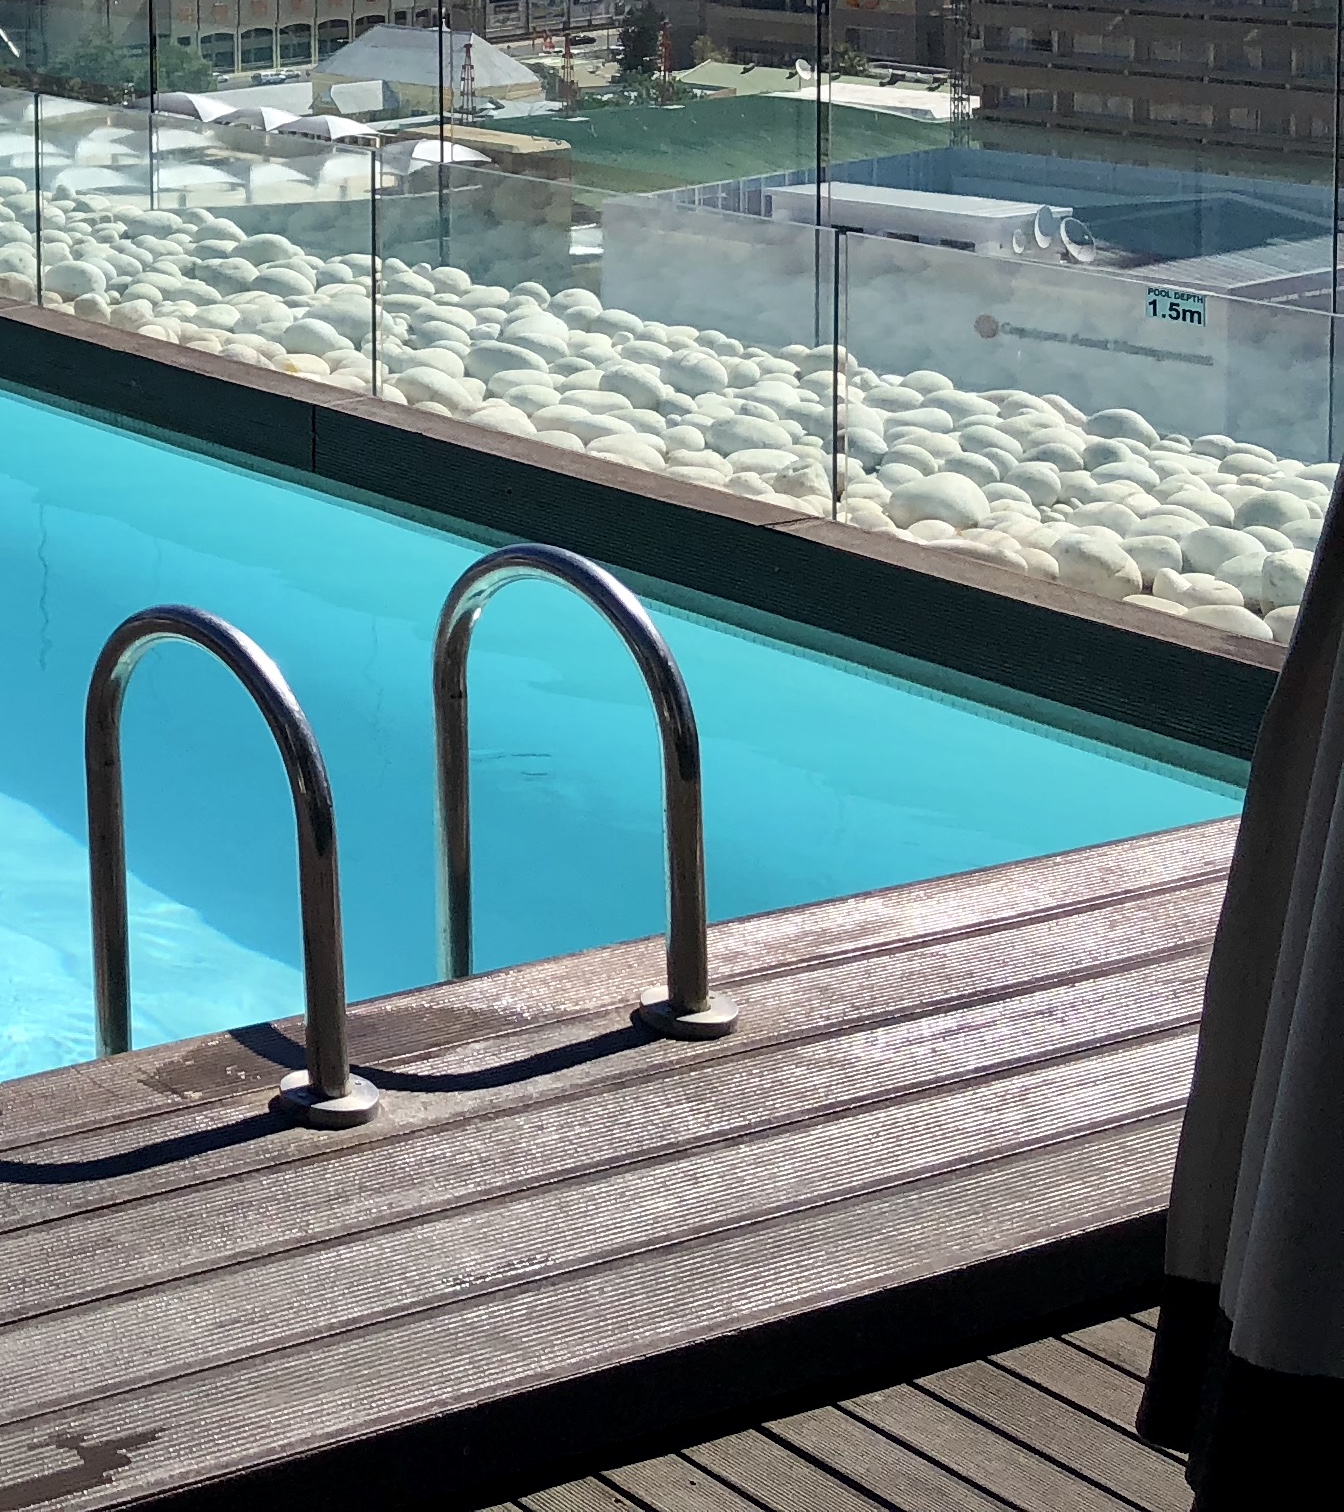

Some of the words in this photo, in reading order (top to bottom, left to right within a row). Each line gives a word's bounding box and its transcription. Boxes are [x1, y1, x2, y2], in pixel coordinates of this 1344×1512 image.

[1147, 287, 1172, 299] POOL
[1173, 291, 1204, 304] DEPTH
[1148, 298, 1202, 325] 1.5m
